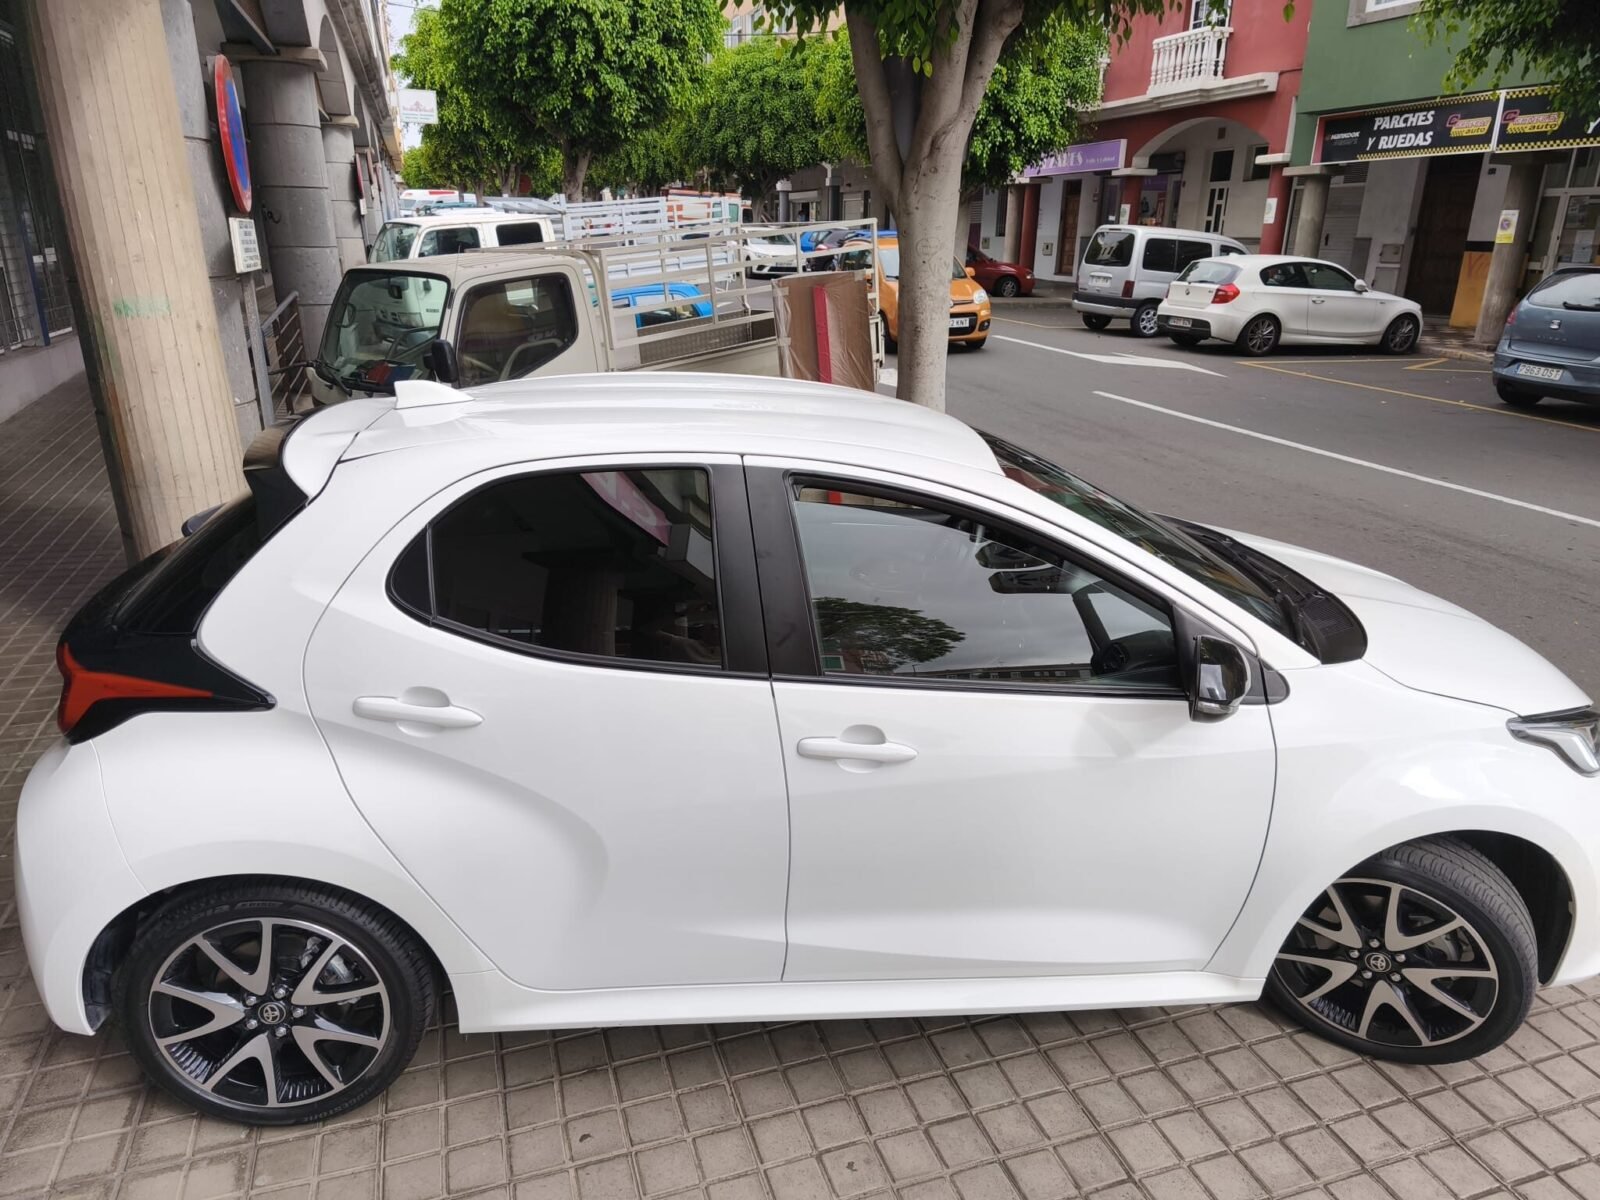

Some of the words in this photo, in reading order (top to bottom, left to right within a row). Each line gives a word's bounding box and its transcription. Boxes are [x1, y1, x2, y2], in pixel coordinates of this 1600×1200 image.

[1373, 110, 1436, 131] PARCHES
[1528, 122, 1558, 131] auto
[1464, 126, 1486, 135] auto
[1366, 137, 1377, 151] Y
[1378, 131, 1434, 150] RUEDAS
